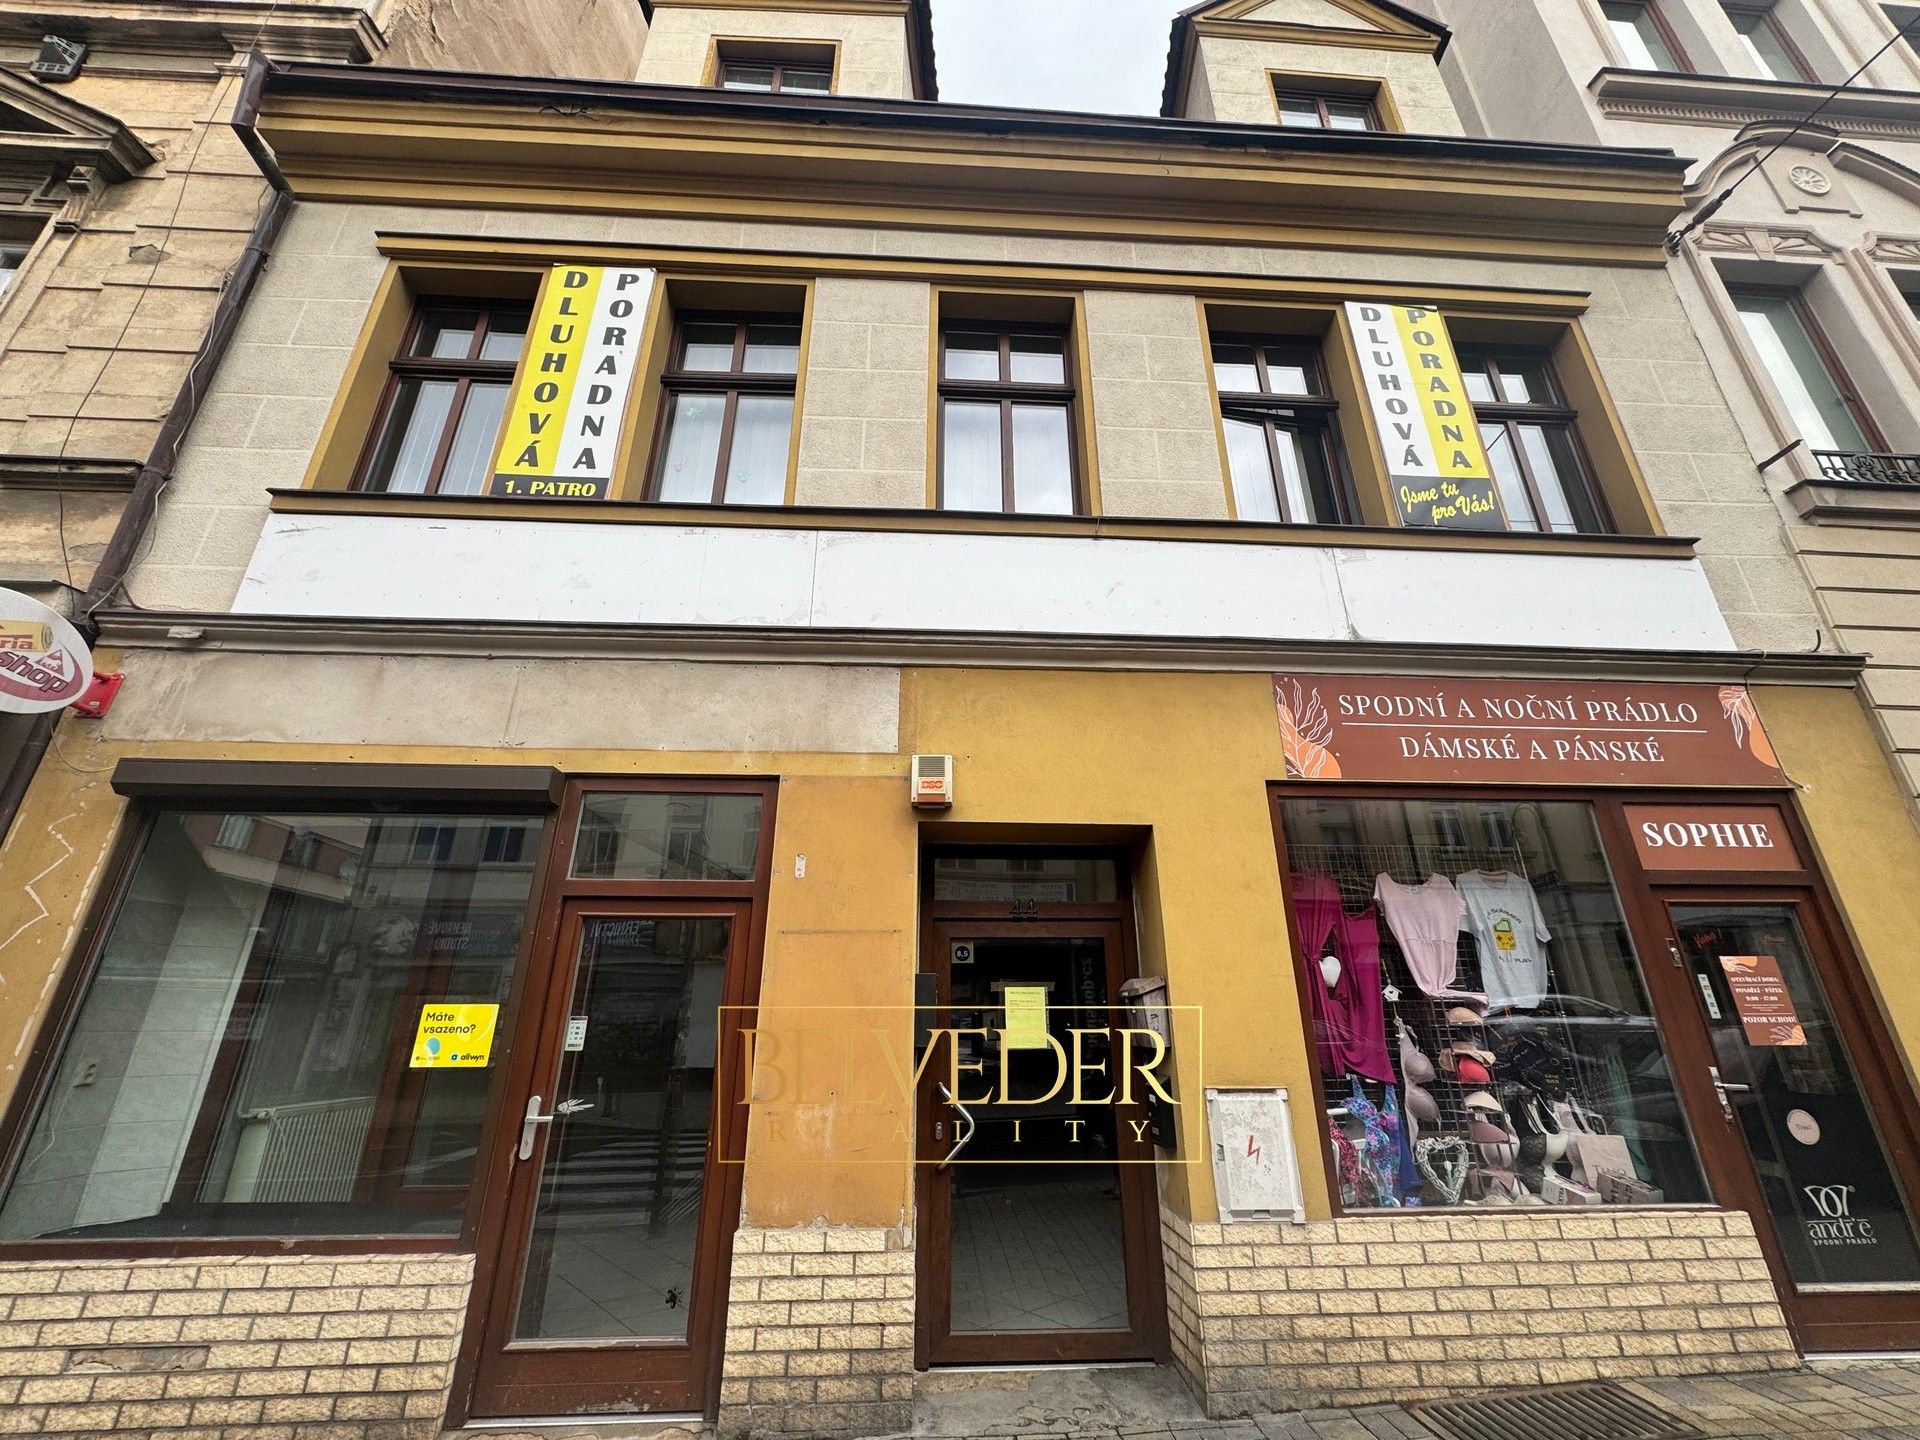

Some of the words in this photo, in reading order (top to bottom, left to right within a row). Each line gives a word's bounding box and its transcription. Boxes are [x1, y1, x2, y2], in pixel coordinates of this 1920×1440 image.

[514, 271, 588, 467] DLUHOVÁ
[573, 274, 640, 470] PORADNA
[1360, 307, 1423, 467] DLUHOVÁ
[1407, 309, 1472, 469] PORADNA
[505, 480, 522, 494] 1.
[530, 482, 597, 496] PATRO
[1400, 486, 1439, 513] Jsme
[1443, 481, 1460, 498] tu
[1432, 503, 1456, 525] pro
[1456, 491, 1494, 516] Vás!
[1338, 691, 1448, 719] SPODNÍ
[1457, 698, 1476, 719] A
[1481, 693, 1579, 721] NOČNÍ
[1584, 695, 1699, 724] PRÁDLO
[1398, 732, 1520, 760] DÁMSKÉ
[1529, 739, 1549, 760] A
[1553, 735, 1666, 763] PÁNSKÉ
[921, 780, 943, 789] DSC
[1642, 822, 1775, 848] SOPHIE
[1735, 986, 1760, 994] PONDĚLÍ
[423, 1023, 477, 1034] vsazeno?
[425, 1012, 455, 1022] Máte
[1742, 1016, 1769, 1024] POZOR
[460, 1053, 485, 1062] allwyn
